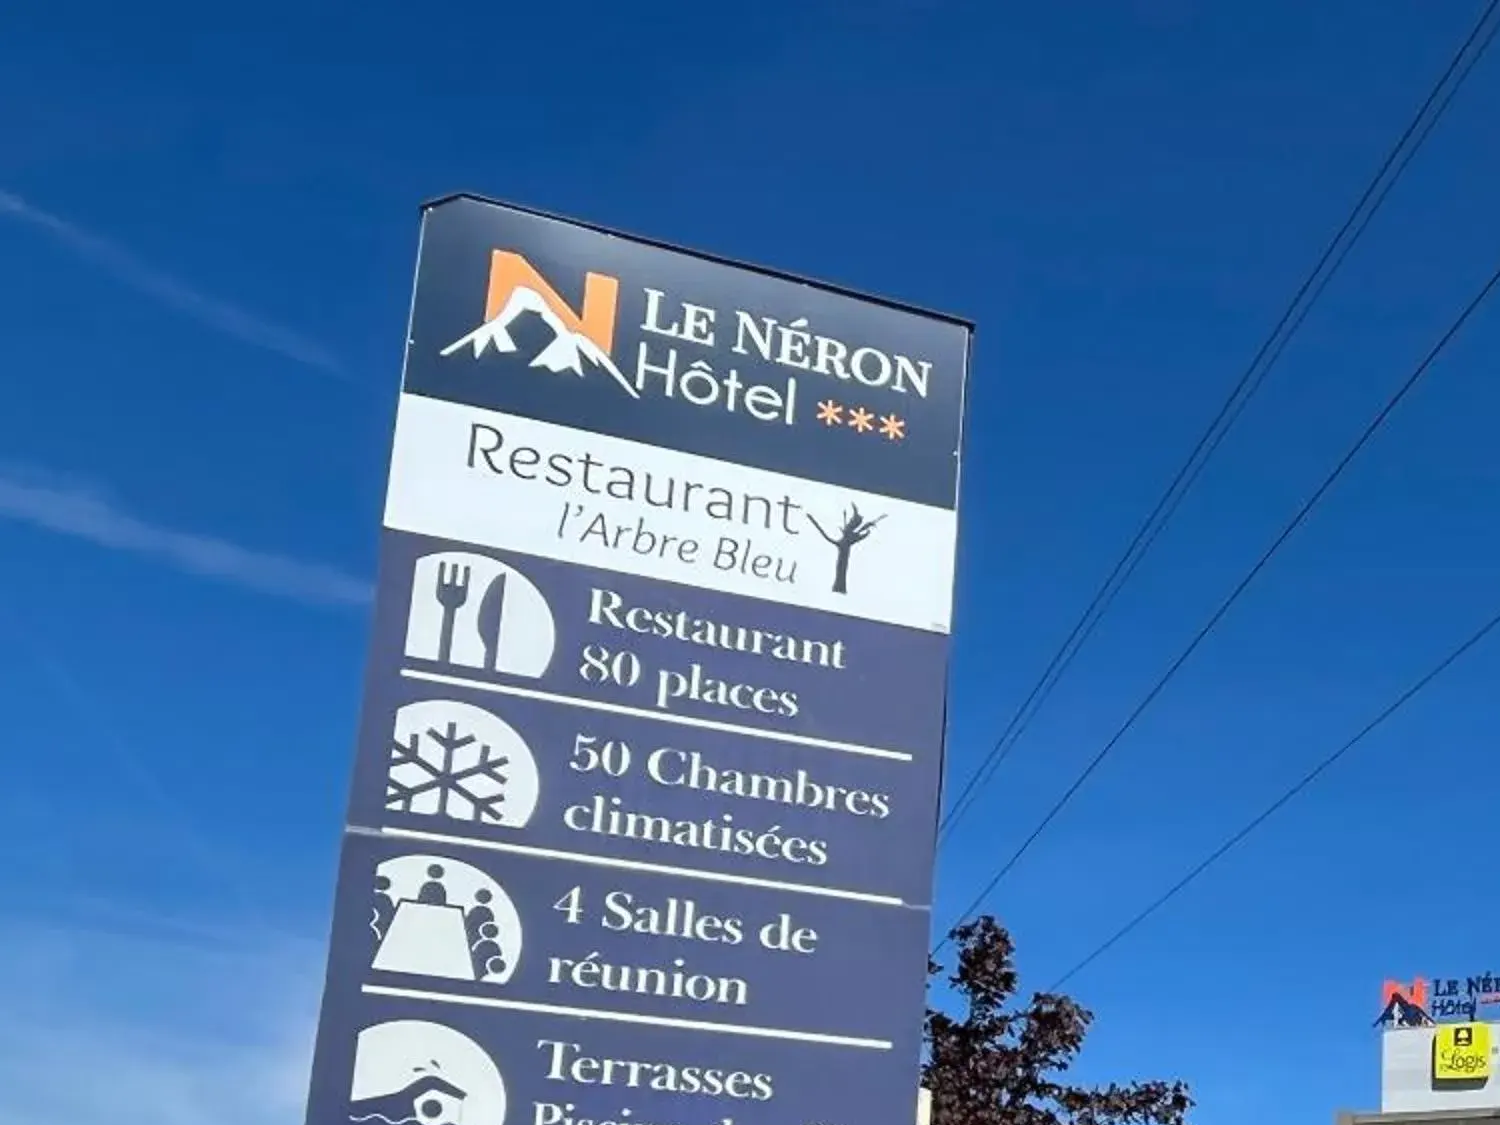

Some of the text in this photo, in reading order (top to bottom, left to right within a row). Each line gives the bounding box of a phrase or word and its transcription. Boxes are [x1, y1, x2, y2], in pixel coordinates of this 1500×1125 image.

[640, 287, 932, 398] LE NÉRON
[635, 342, 797, 425] Hôtel
[466, 422, 801, 535] Restaurant
[712, 536, 798, 585] Bleu
[588, 587, 847, 670] Restaurant
[579, 644, 799, 718] 80 places
[569, 733, 891, 819] 50 Chambres
[563, 796, 827, 867] climatisées
[553, 885, 819, 954] 4 Salles de
[548, 953, 748, 1005] réunion
[1433, 979, 1459, 997] LE
[538, 1040, 773, 1101] Terrasses
